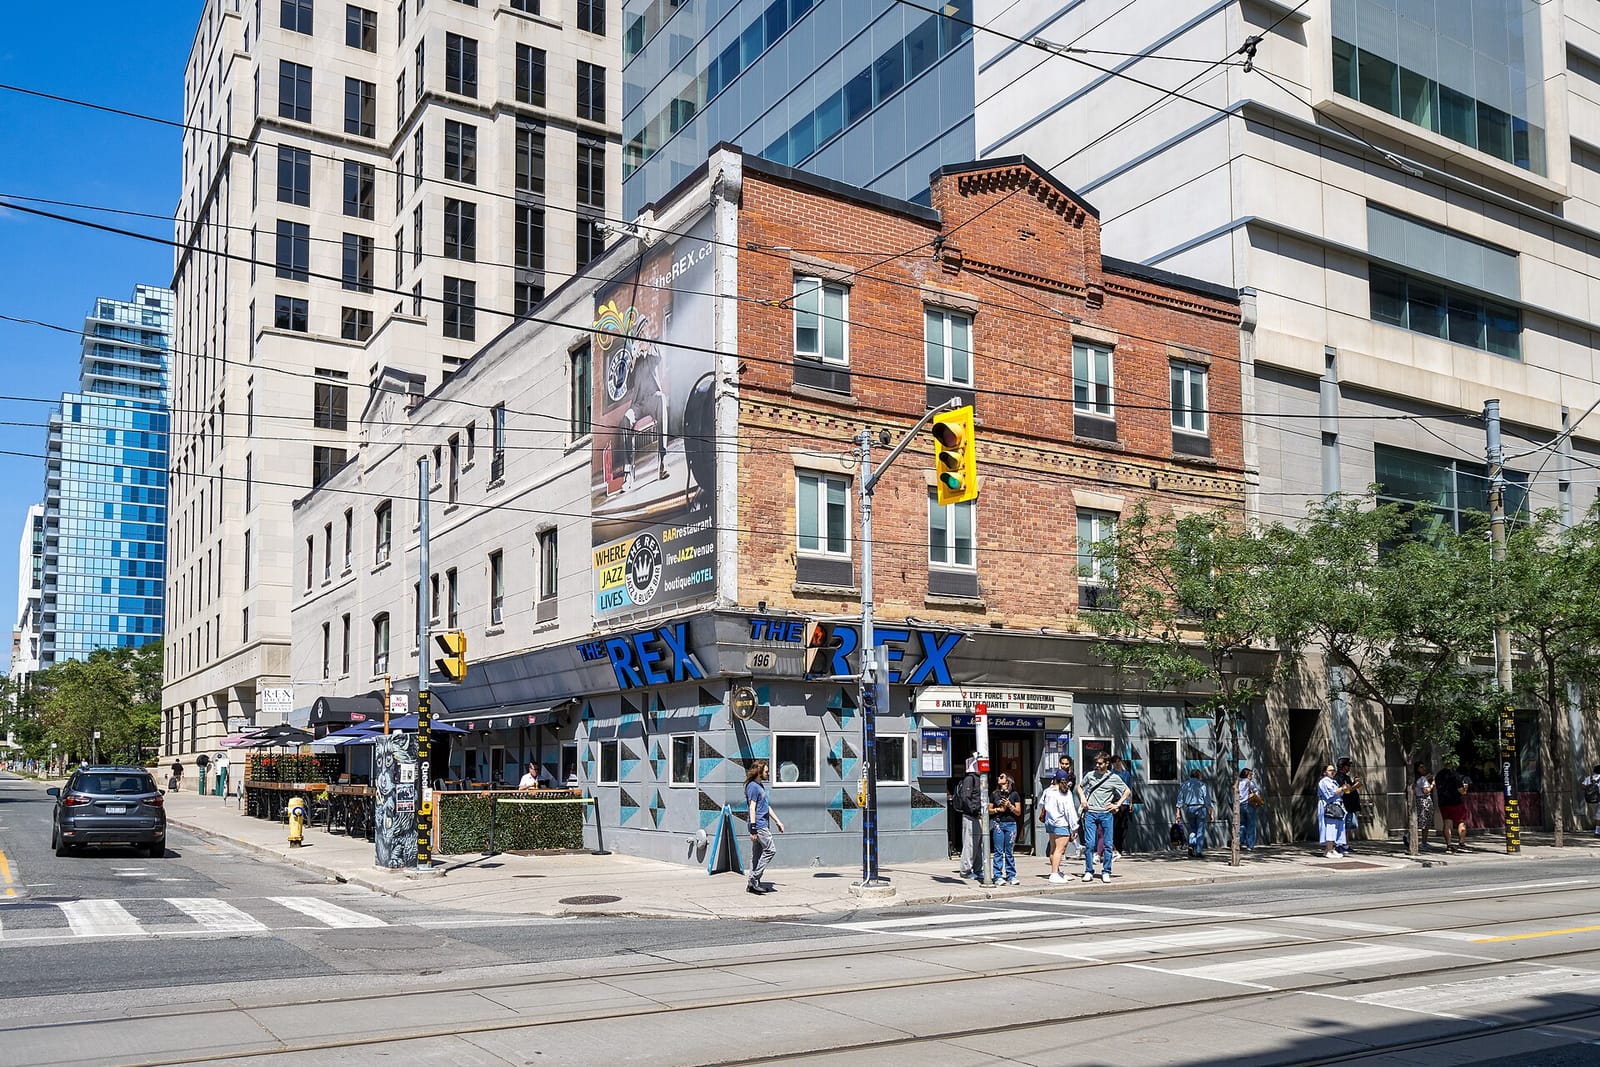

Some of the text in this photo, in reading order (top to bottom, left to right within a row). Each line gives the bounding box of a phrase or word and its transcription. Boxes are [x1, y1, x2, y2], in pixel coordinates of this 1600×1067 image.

[655, 241, 713, 291] theREX.ca
[595, 543, 626, 567] WHERE
[627, 536, 659, 564] THE REX
[602, 566, 623, 589] JAZZ
[601, 590, 624, 610] LIVES
[750, 620, 804, 643] THE
[576, 622, 704, 690] THE REX
[753, 653, 770, 667] 196
[984, 692, 1003, 700] FORCE
[995, 718, 1015, 726] Blues
[1016, 719, 1031, 727] Bar
[421, 761, 430, 789] Quee
